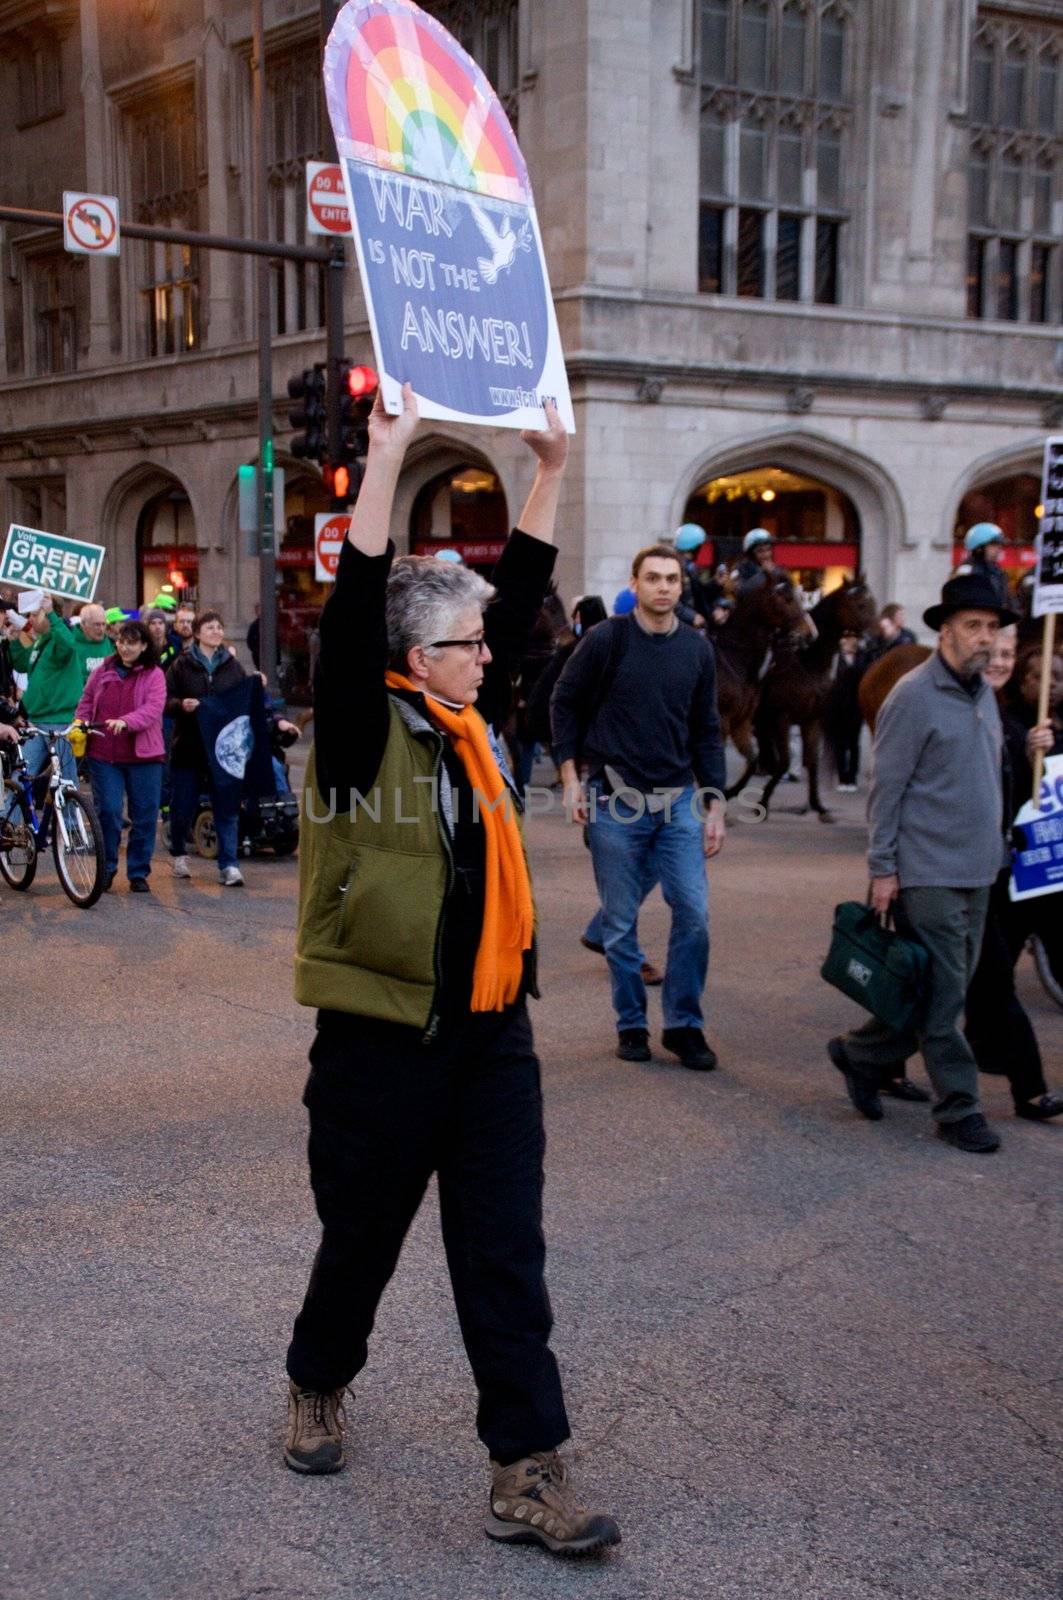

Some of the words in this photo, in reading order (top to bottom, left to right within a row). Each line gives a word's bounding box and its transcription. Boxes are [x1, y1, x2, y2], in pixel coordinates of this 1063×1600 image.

[316, 176, 331, 190] DO
[320, 206, 350, 222] ENTE
[367, 169, 453, 238] WAR
[367, 238, 386, 265] IS
[389, 244, 436, 292] NOT
[439, 262, 481, 292] THE
[400, 301, 534, 369] ANSWER!
[17, 530, 38, 543] Vote
[324, 527, 339, 538] DO
[12, 539, 97, 576] GREEN
[7, 558, 90, 594] PARTY
